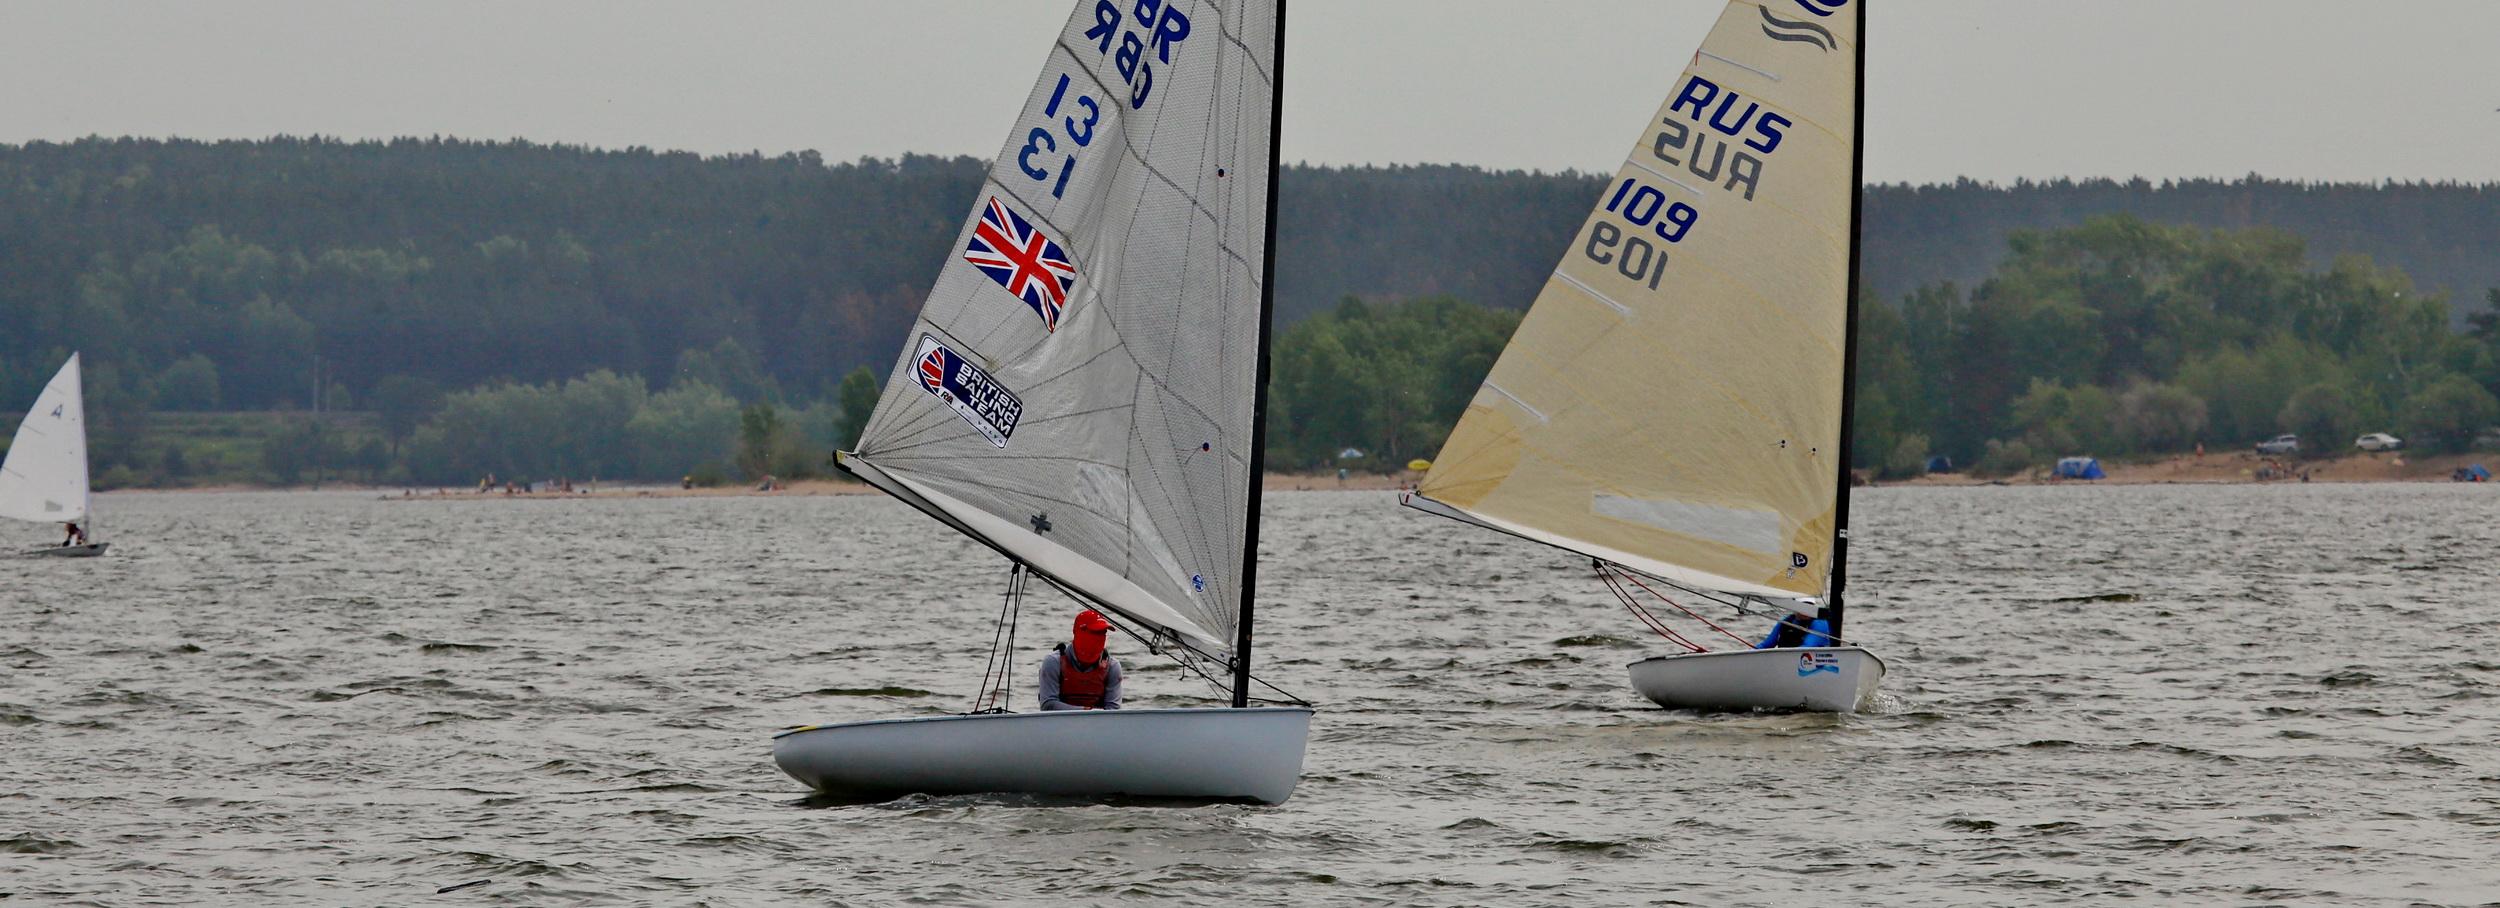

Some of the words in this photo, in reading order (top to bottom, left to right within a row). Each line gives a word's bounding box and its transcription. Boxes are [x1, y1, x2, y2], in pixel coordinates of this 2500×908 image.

[1045, 73, 1099, 147] 13
[1670, 75, 1792, 154] RUS
[1605, 178, 1698, 243] 109
[955, 372, 1016, 426] SAILING
[959, 363, 1020, 416] BRITISH
[969, 395, 1011, 435] TEAM
